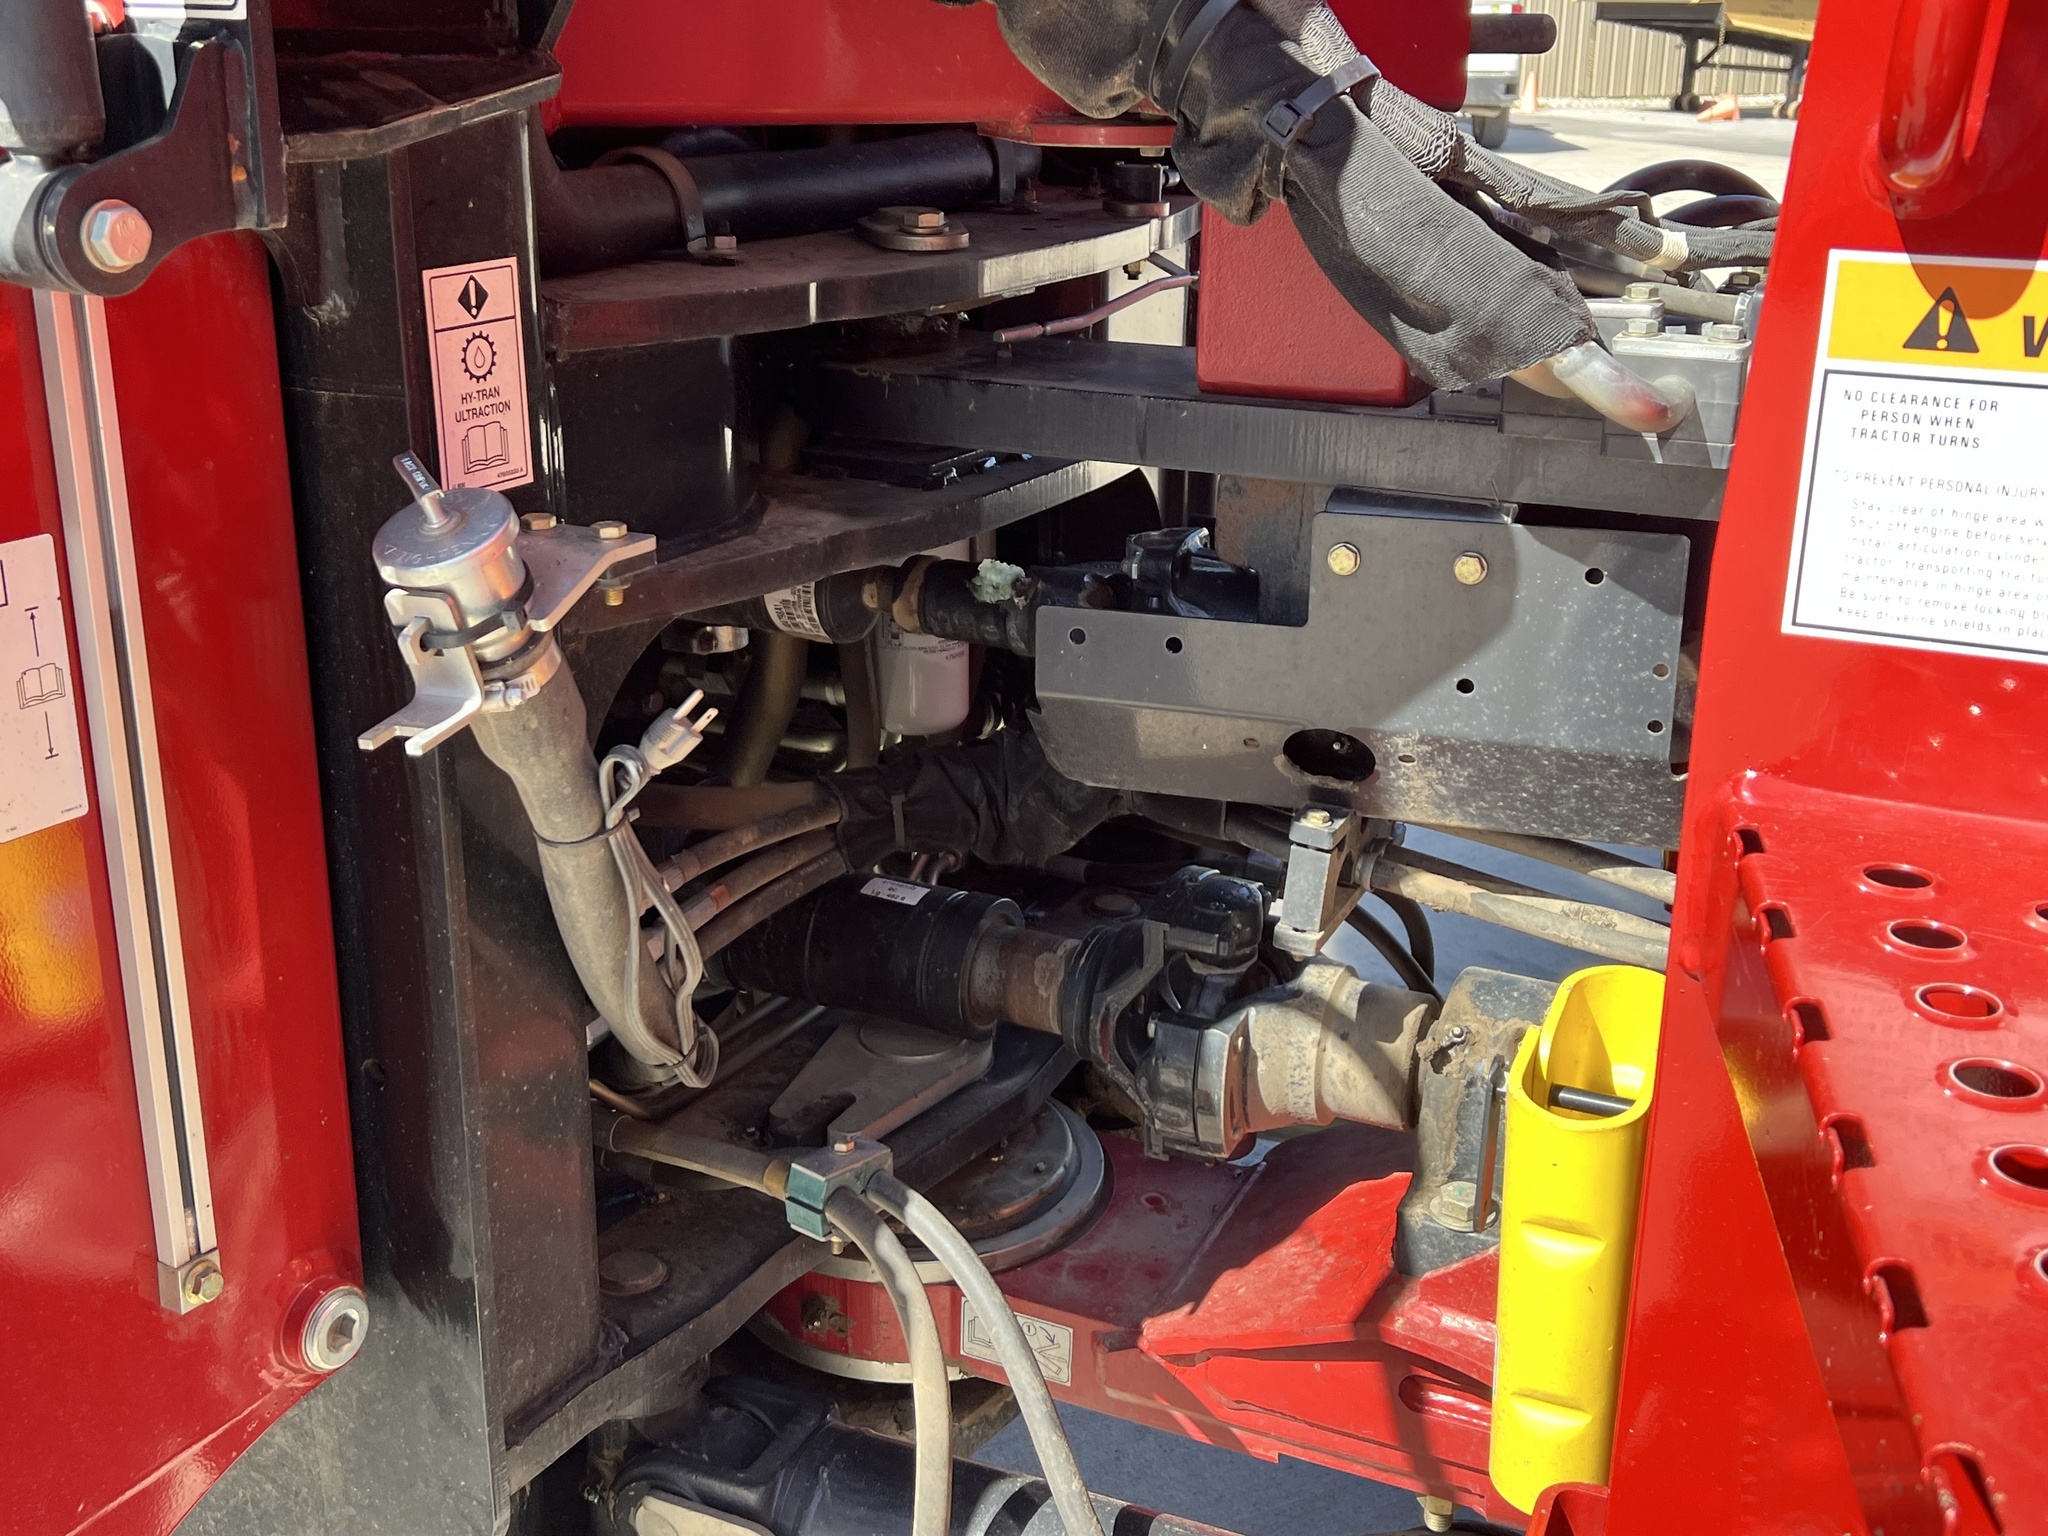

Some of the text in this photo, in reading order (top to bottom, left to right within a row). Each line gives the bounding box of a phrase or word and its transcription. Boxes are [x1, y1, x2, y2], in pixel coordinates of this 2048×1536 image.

[461, 386, 500, 405] HY-TRAN
[1844, 389, 1998, 411] NO CLEARANCE FOR
[455, 400, 511, 423] ULTRACTION
[1861, 409, 1975, 429] PERSON WHEN
[1851, 427, 1980, 448] TRACTOR TURNS
[1856, 472, 1913, 487] PREVENT
[1921, 478, 1988, 495] PERSONAL
[1952, 509, 1988, 523] hinge
[1997, 515, 2026, 525] area
[1914, 525, 1959, 538] engine
[1966, 529, 2011, 543] before
[1898, 542, 1980, 557] articulation
[1905, 560, 1992, 580] transporting
[1842, 572, 1929, 589] mantenance
[1955, 582, 1991, 598] hinge
[1999, 589, 2029, 600] area
[1840, 587, 1855, 599] Be
[1919, 599, 1967, 611] remove
[1876, 611, 1935, 626] drveline
[1943, 619, 1991, 632] shields
